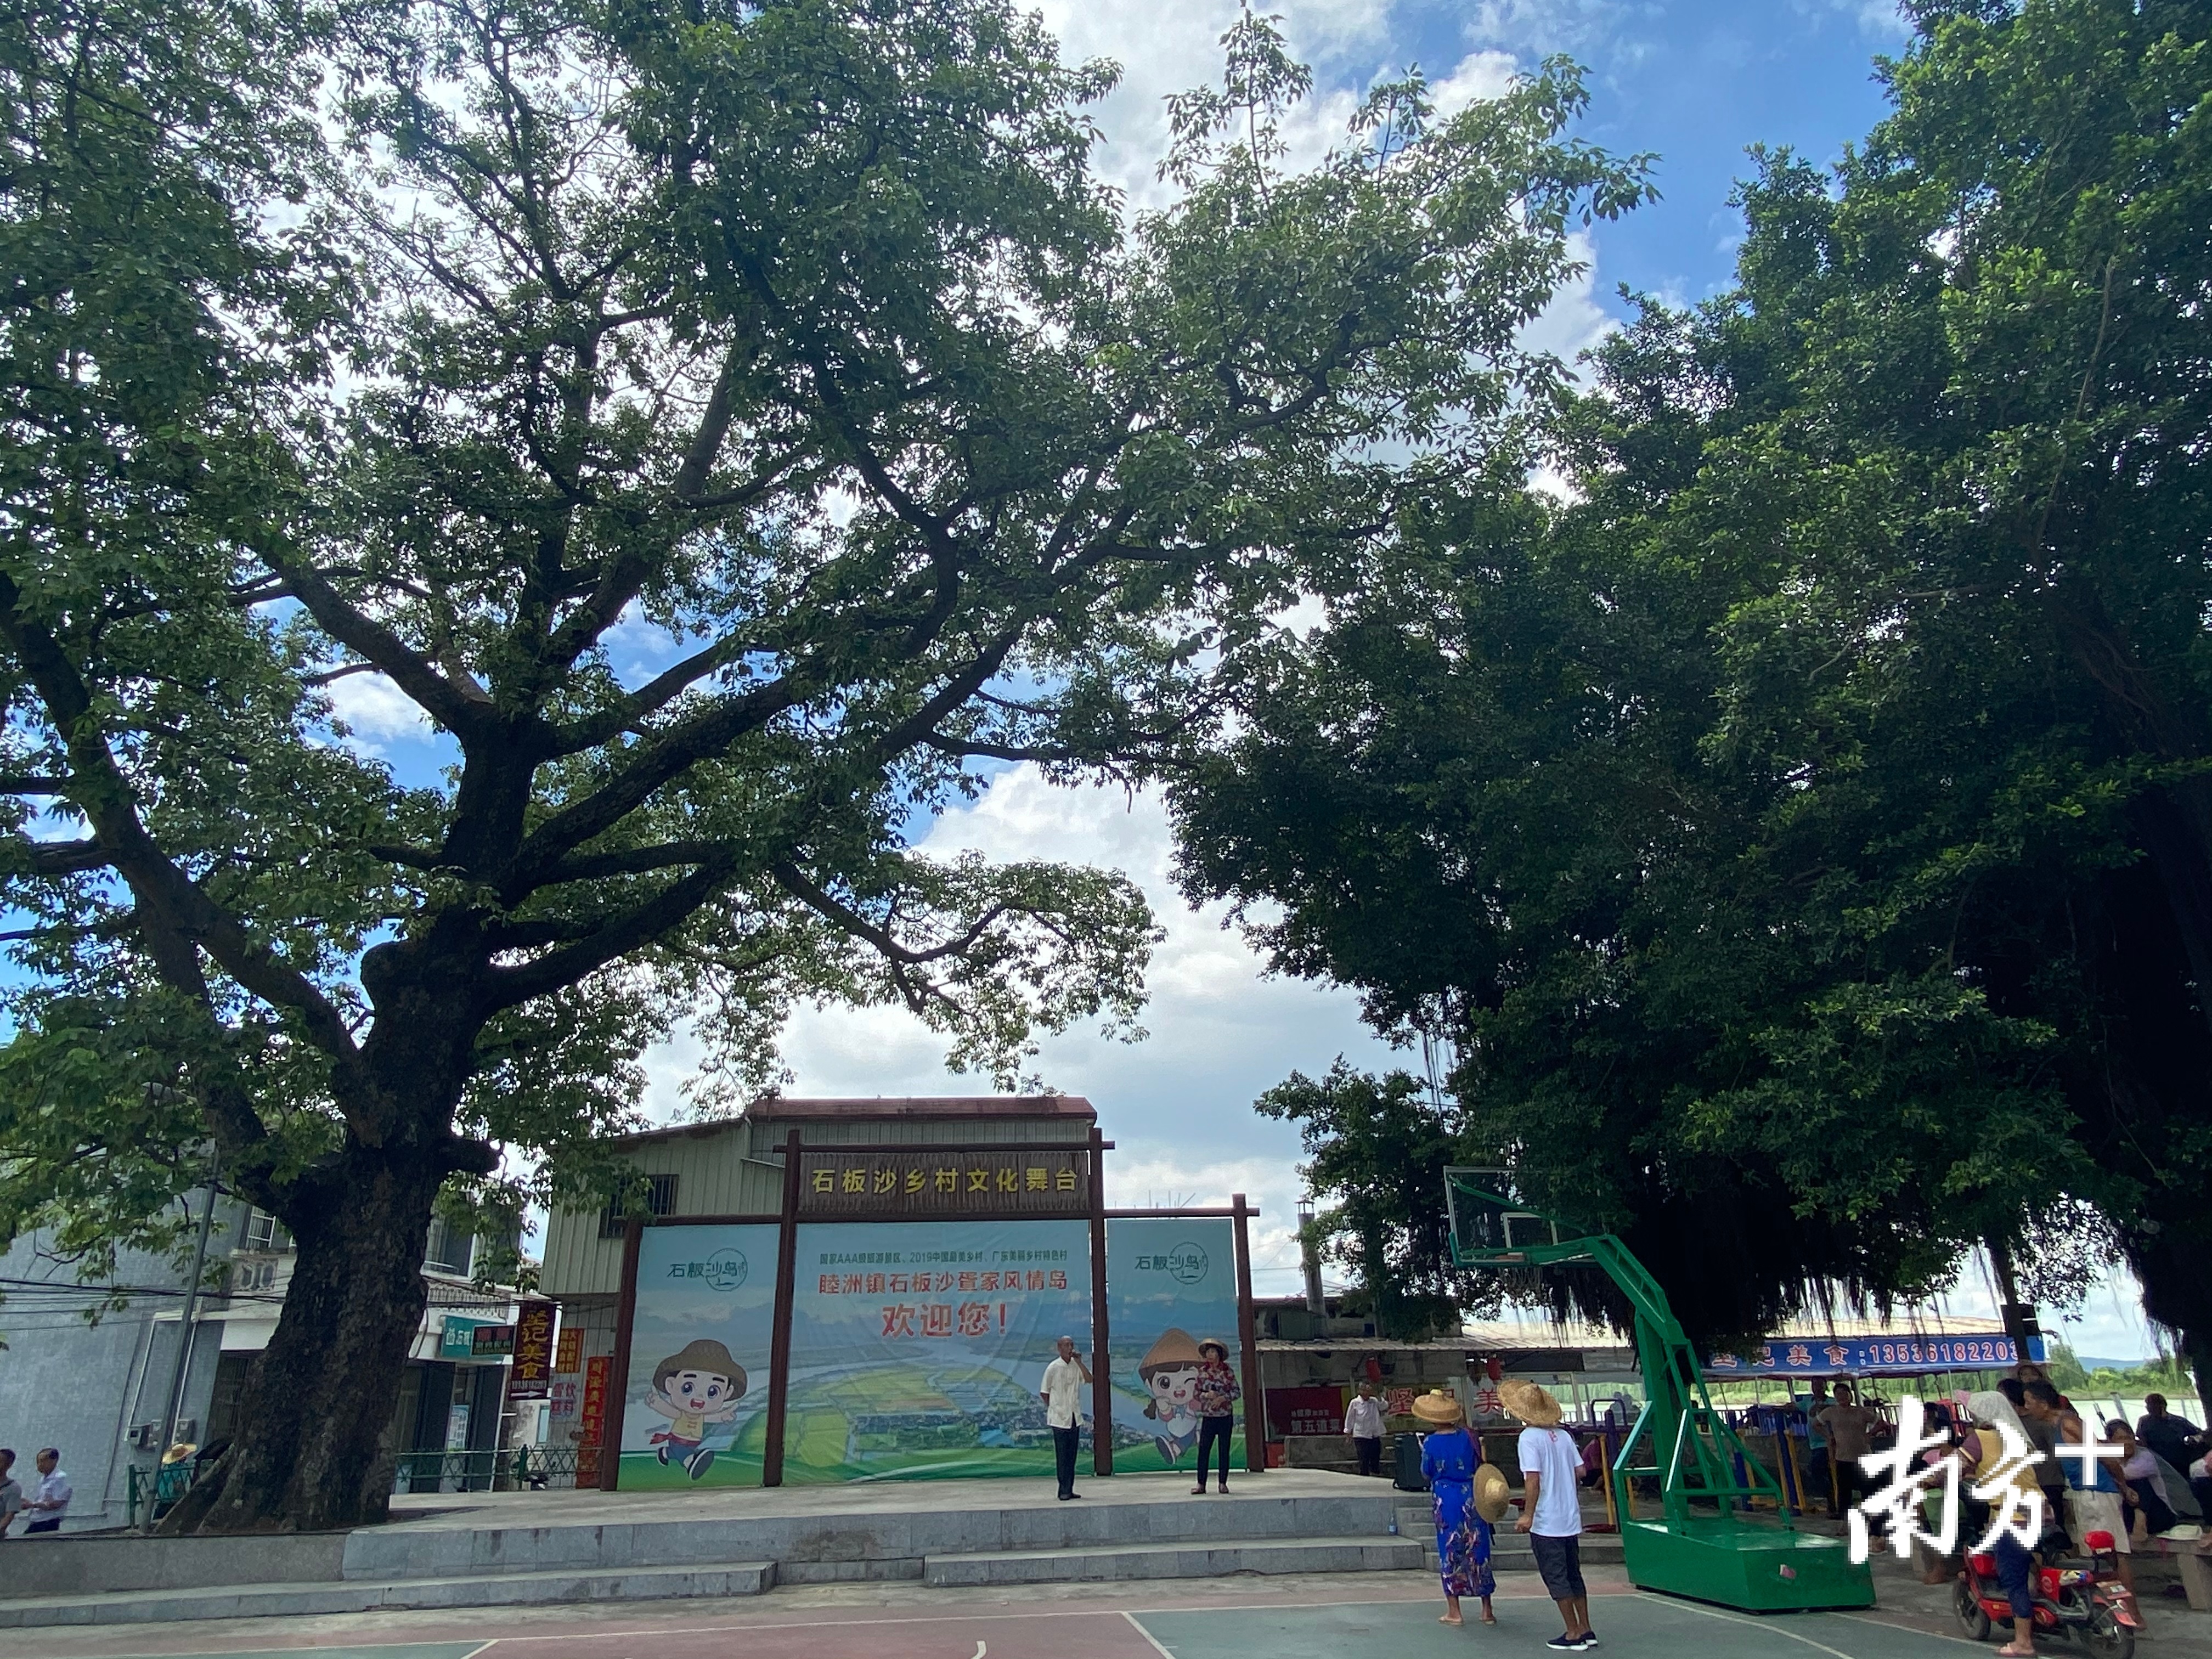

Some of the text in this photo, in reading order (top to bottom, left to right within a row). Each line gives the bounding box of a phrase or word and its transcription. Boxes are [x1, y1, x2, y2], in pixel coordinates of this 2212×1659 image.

[812, 1167, 1078, 1194] 石板沙乡村文化舞台
